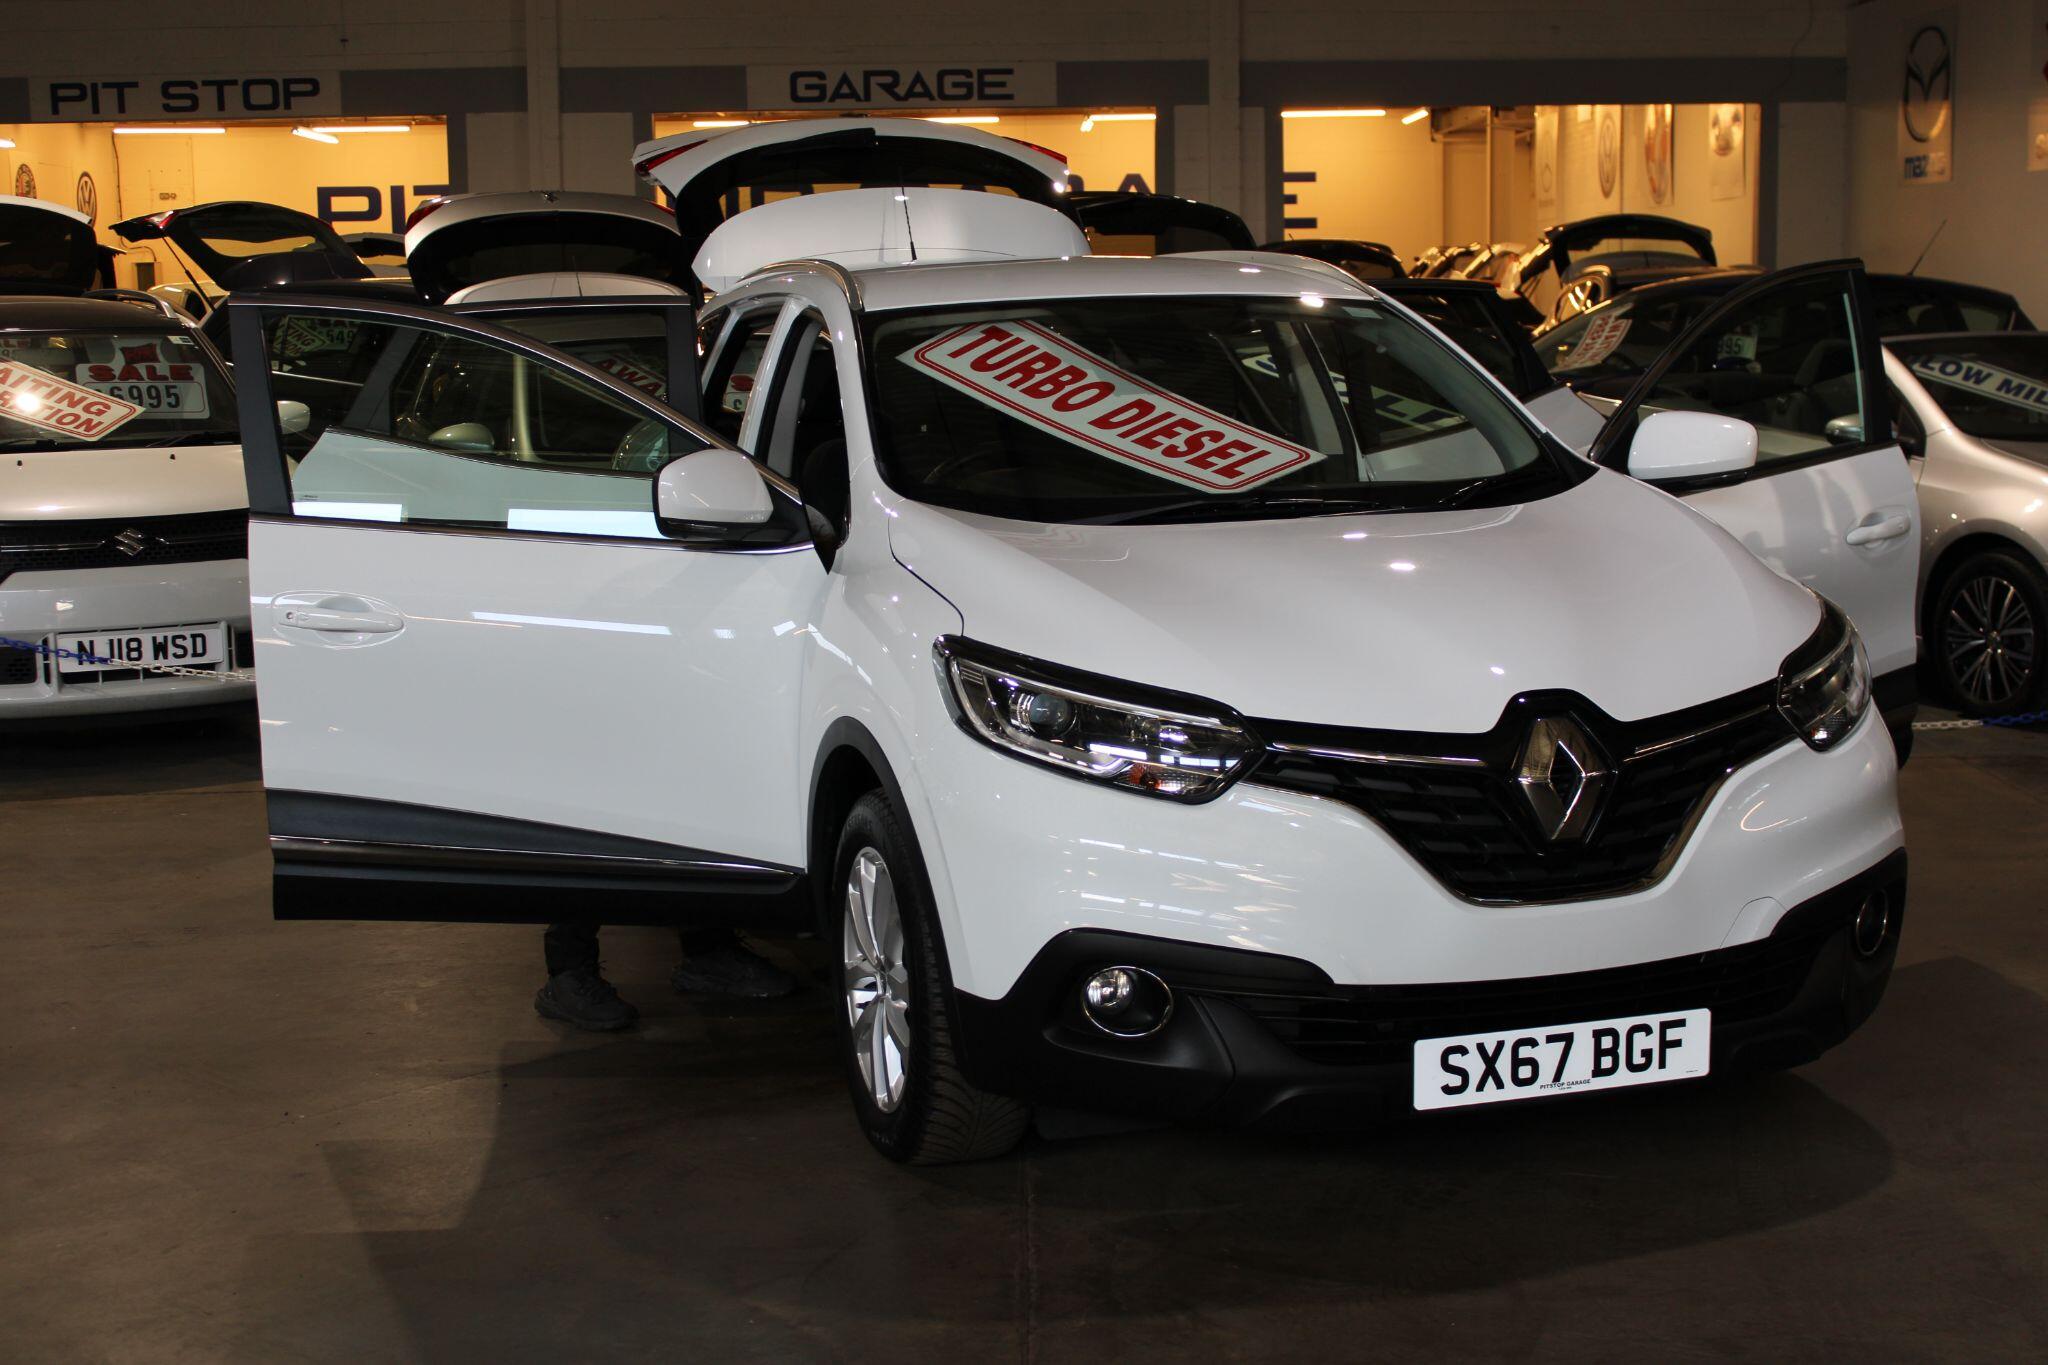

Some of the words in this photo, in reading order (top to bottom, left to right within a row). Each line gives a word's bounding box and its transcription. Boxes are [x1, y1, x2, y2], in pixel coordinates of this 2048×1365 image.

[50, 81, 139, 115] PIT
[161, 77, 321, 113] STOP
[790, 68, 1014, 103] GARAGE
[88, 364, 194, 382] SALE
[1919, 357, 1993, 386] LOW
[946, 325, 1116, 413] TURBO
[1087, 398, 1272, 480] DIESEL
[152, 633, 207, 661] WSD
[1440, 1031, 1575, 1096] SX67
[1591, 1018, 1687, 1079] BGF
